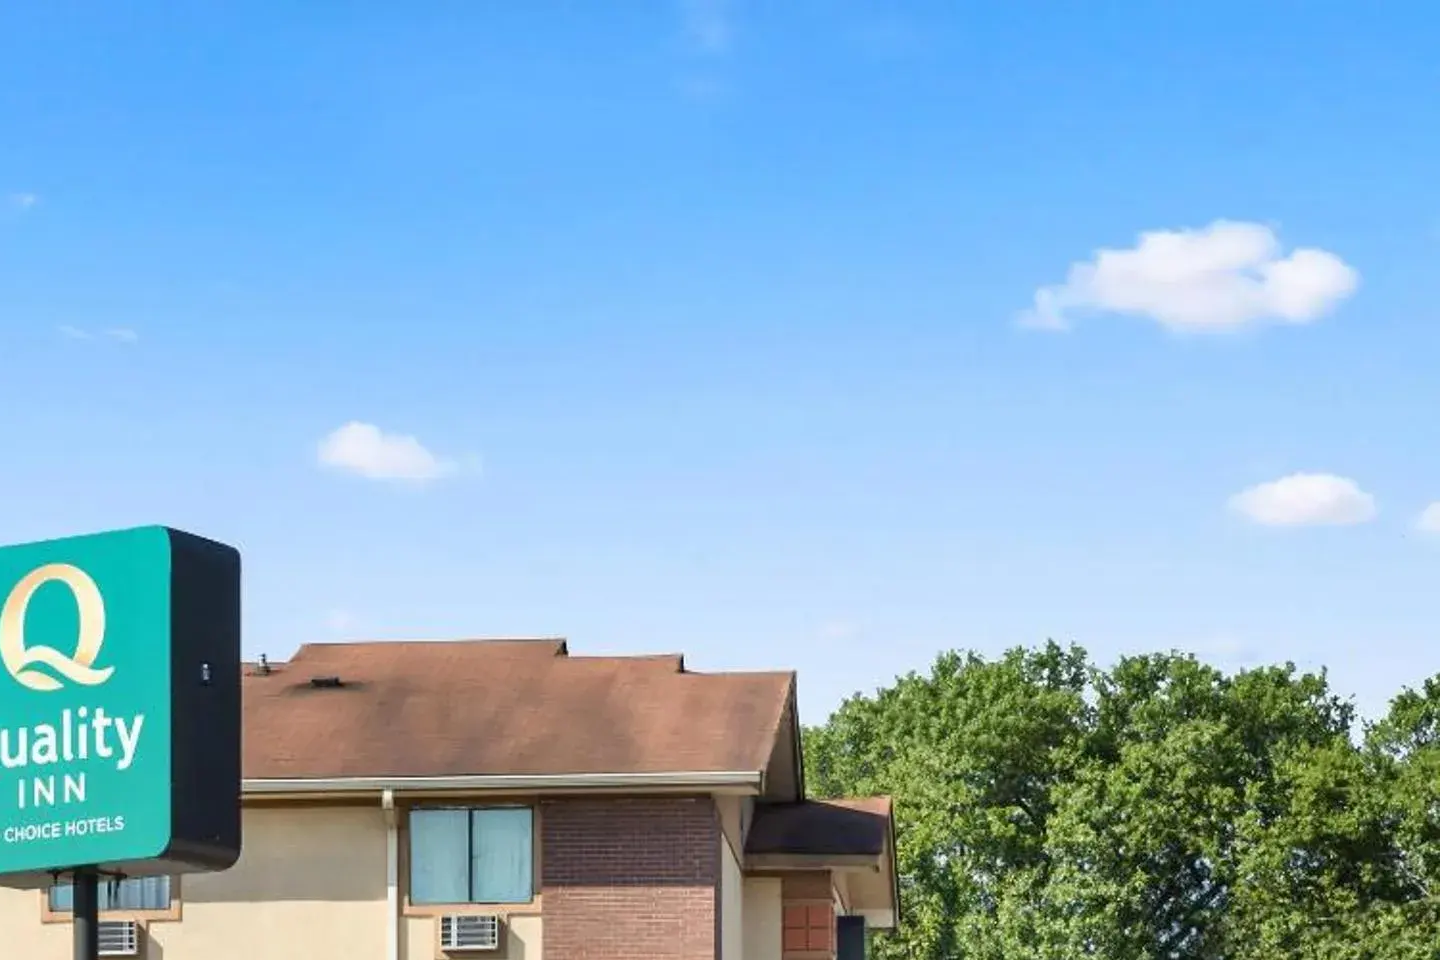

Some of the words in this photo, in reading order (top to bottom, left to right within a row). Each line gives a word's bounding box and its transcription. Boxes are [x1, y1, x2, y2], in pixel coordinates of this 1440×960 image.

[17, 772, 86, 809] INN
[4, 821, 61, 843] CHOICE
[65, 816, 125, 835] HOTELS
